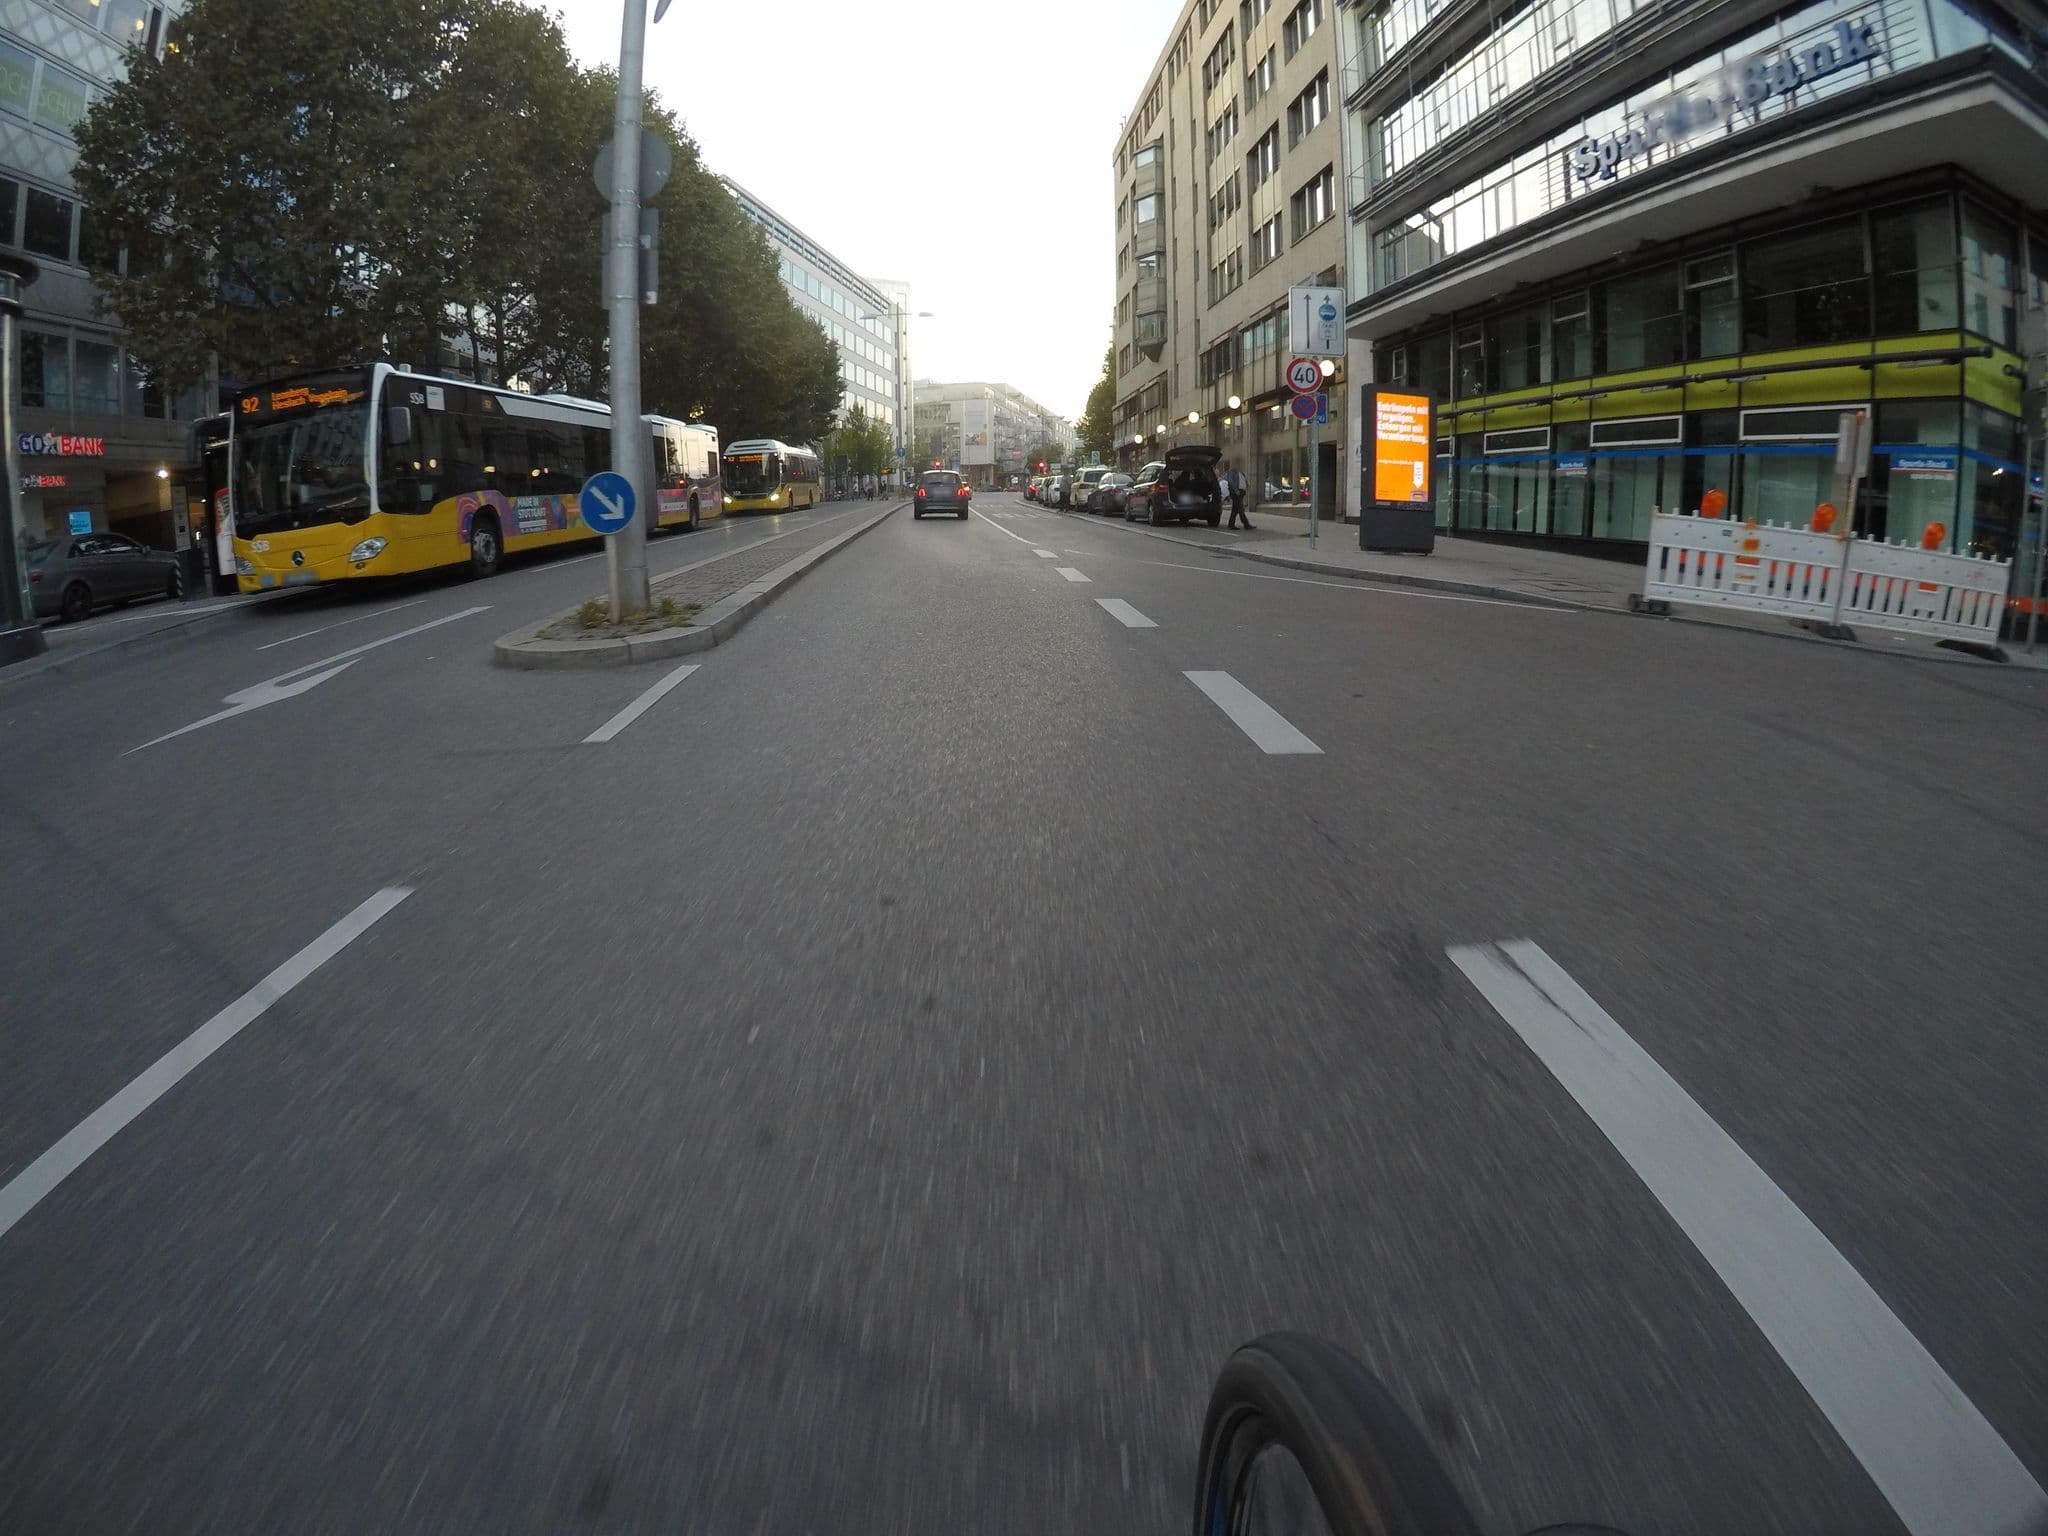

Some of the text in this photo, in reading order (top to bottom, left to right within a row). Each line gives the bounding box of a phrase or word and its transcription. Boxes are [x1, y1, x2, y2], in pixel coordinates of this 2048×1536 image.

[1294, 367, 1316, 384] 40
[242, 397, 260, 413] 92
[59, 435, 104, 456] BANK
